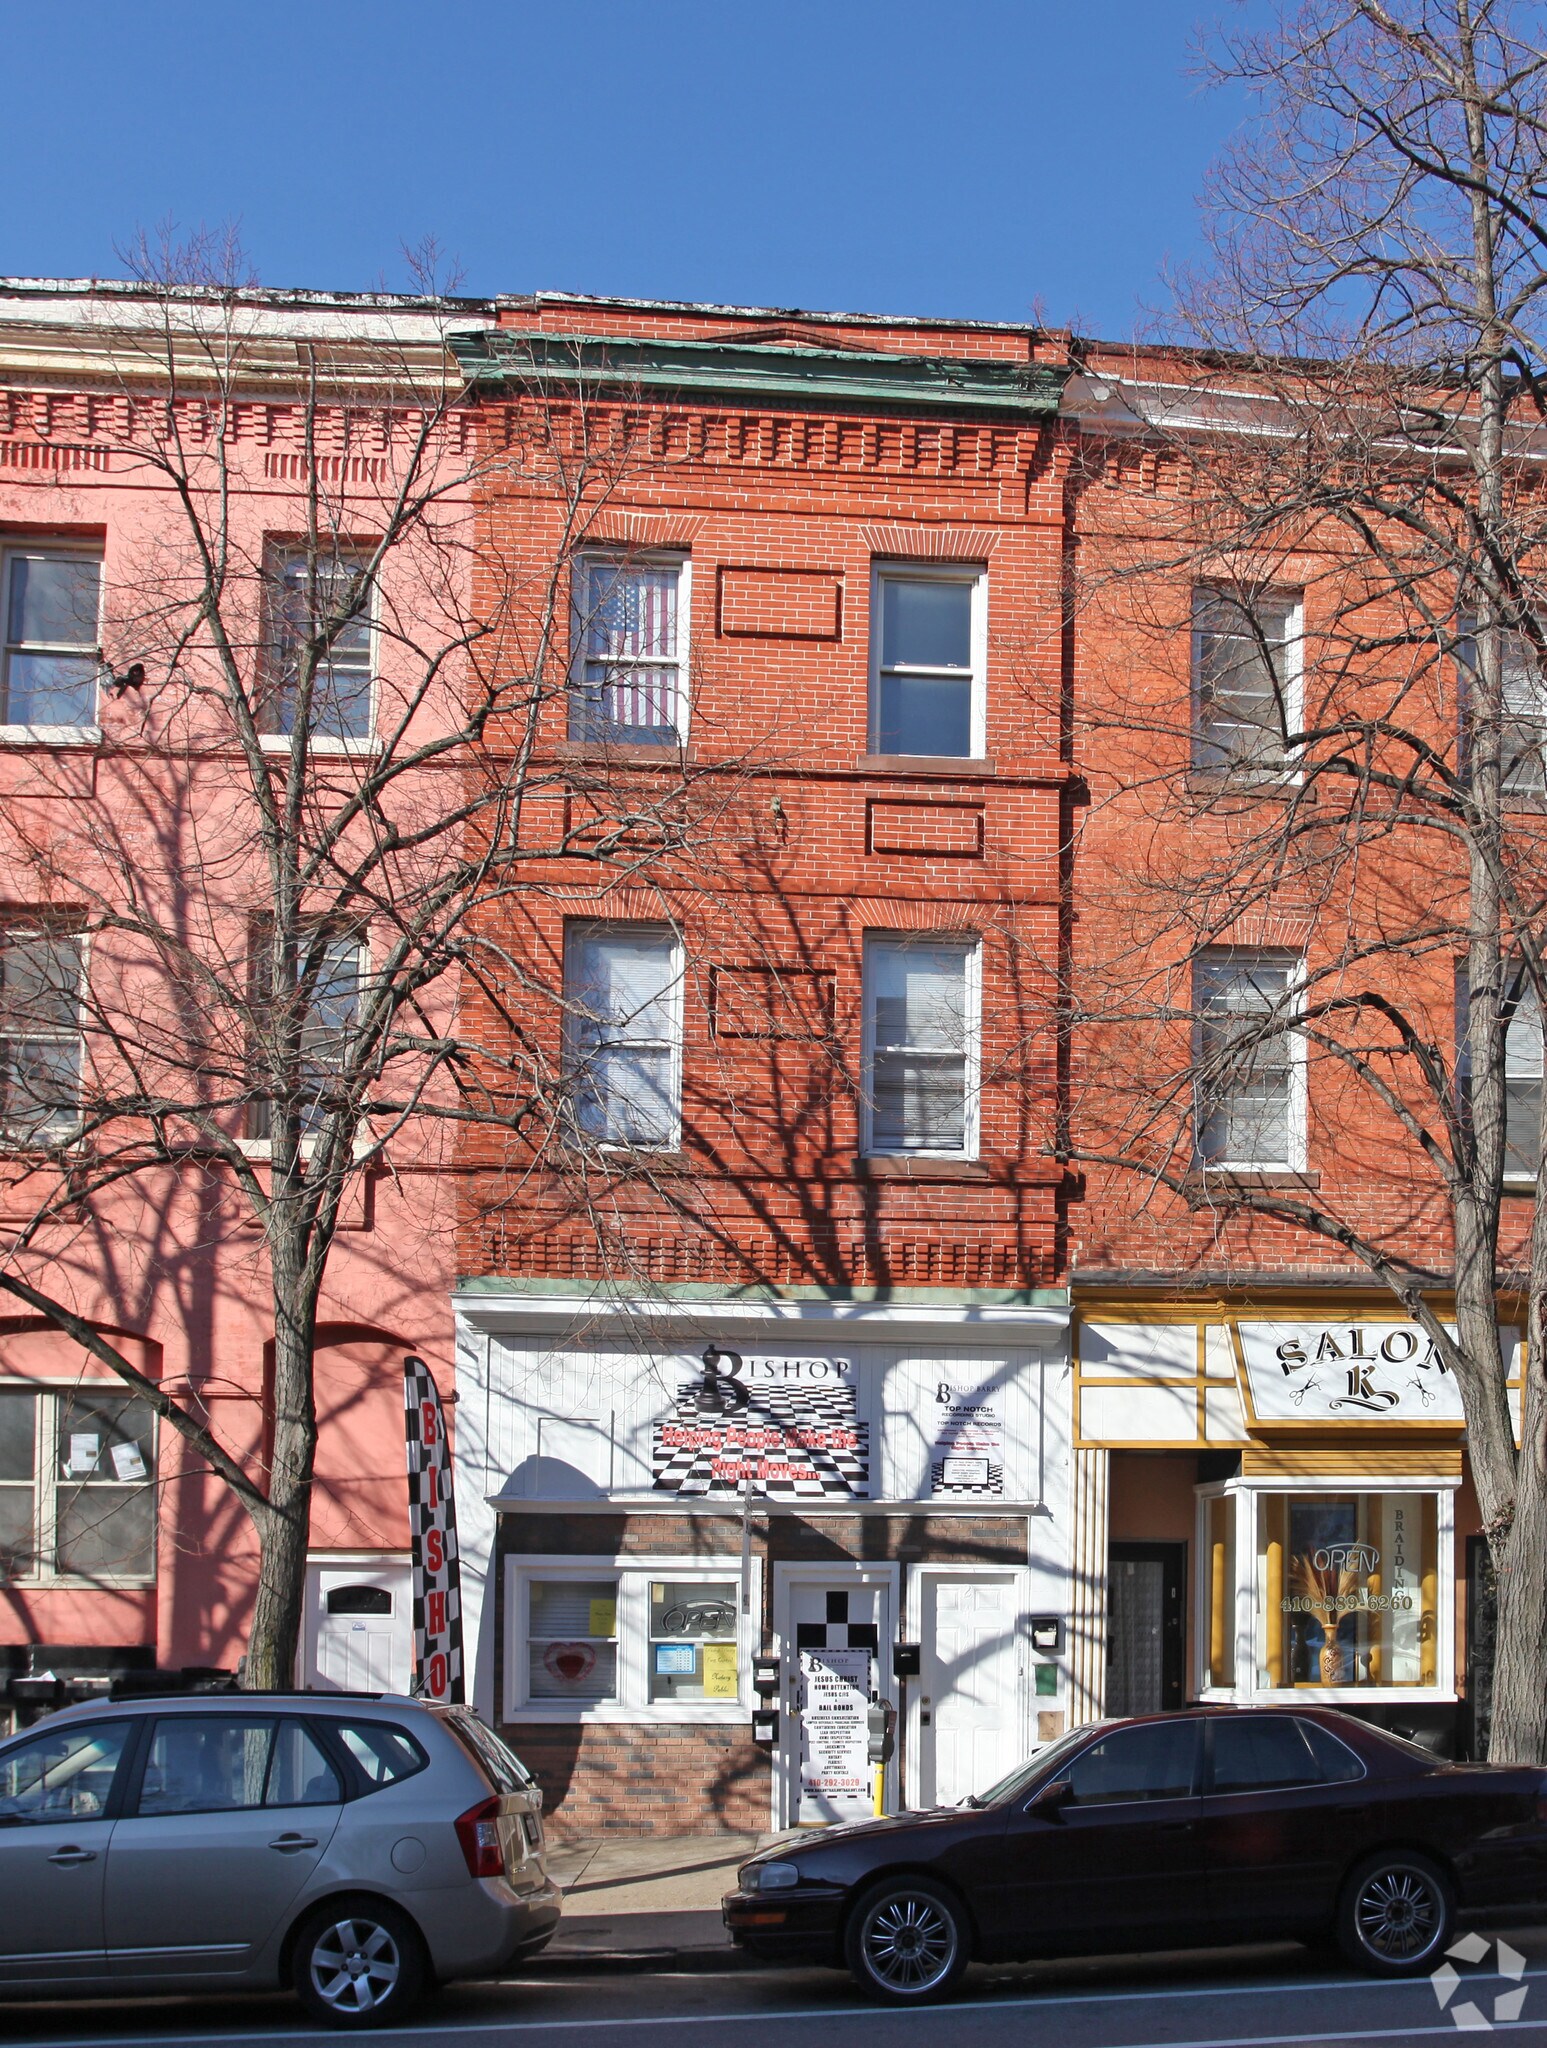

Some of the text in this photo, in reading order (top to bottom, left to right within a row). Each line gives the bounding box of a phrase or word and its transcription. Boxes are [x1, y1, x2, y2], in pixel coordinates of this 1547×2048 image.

[694, 1344, 849, 1415] BISHOP
[1329, 1364, 1400, 1412] K
[936, 1381, 1001, 1404] BISHOP BARRY
[662, 1426, 857, 1451] Helping People Make the
[711, 1458, 821, 1483] Right Moves...
[1314, 1549, 1377, 1573] OPEN
[1394, 1509, 1405, 1601] BRAIDING
[1280, 1595, 1413, 1612] 410-889-6260
[664, 1608, 737, 1632] OPEN
[808, 1656, 849, 1672] BISHOP
